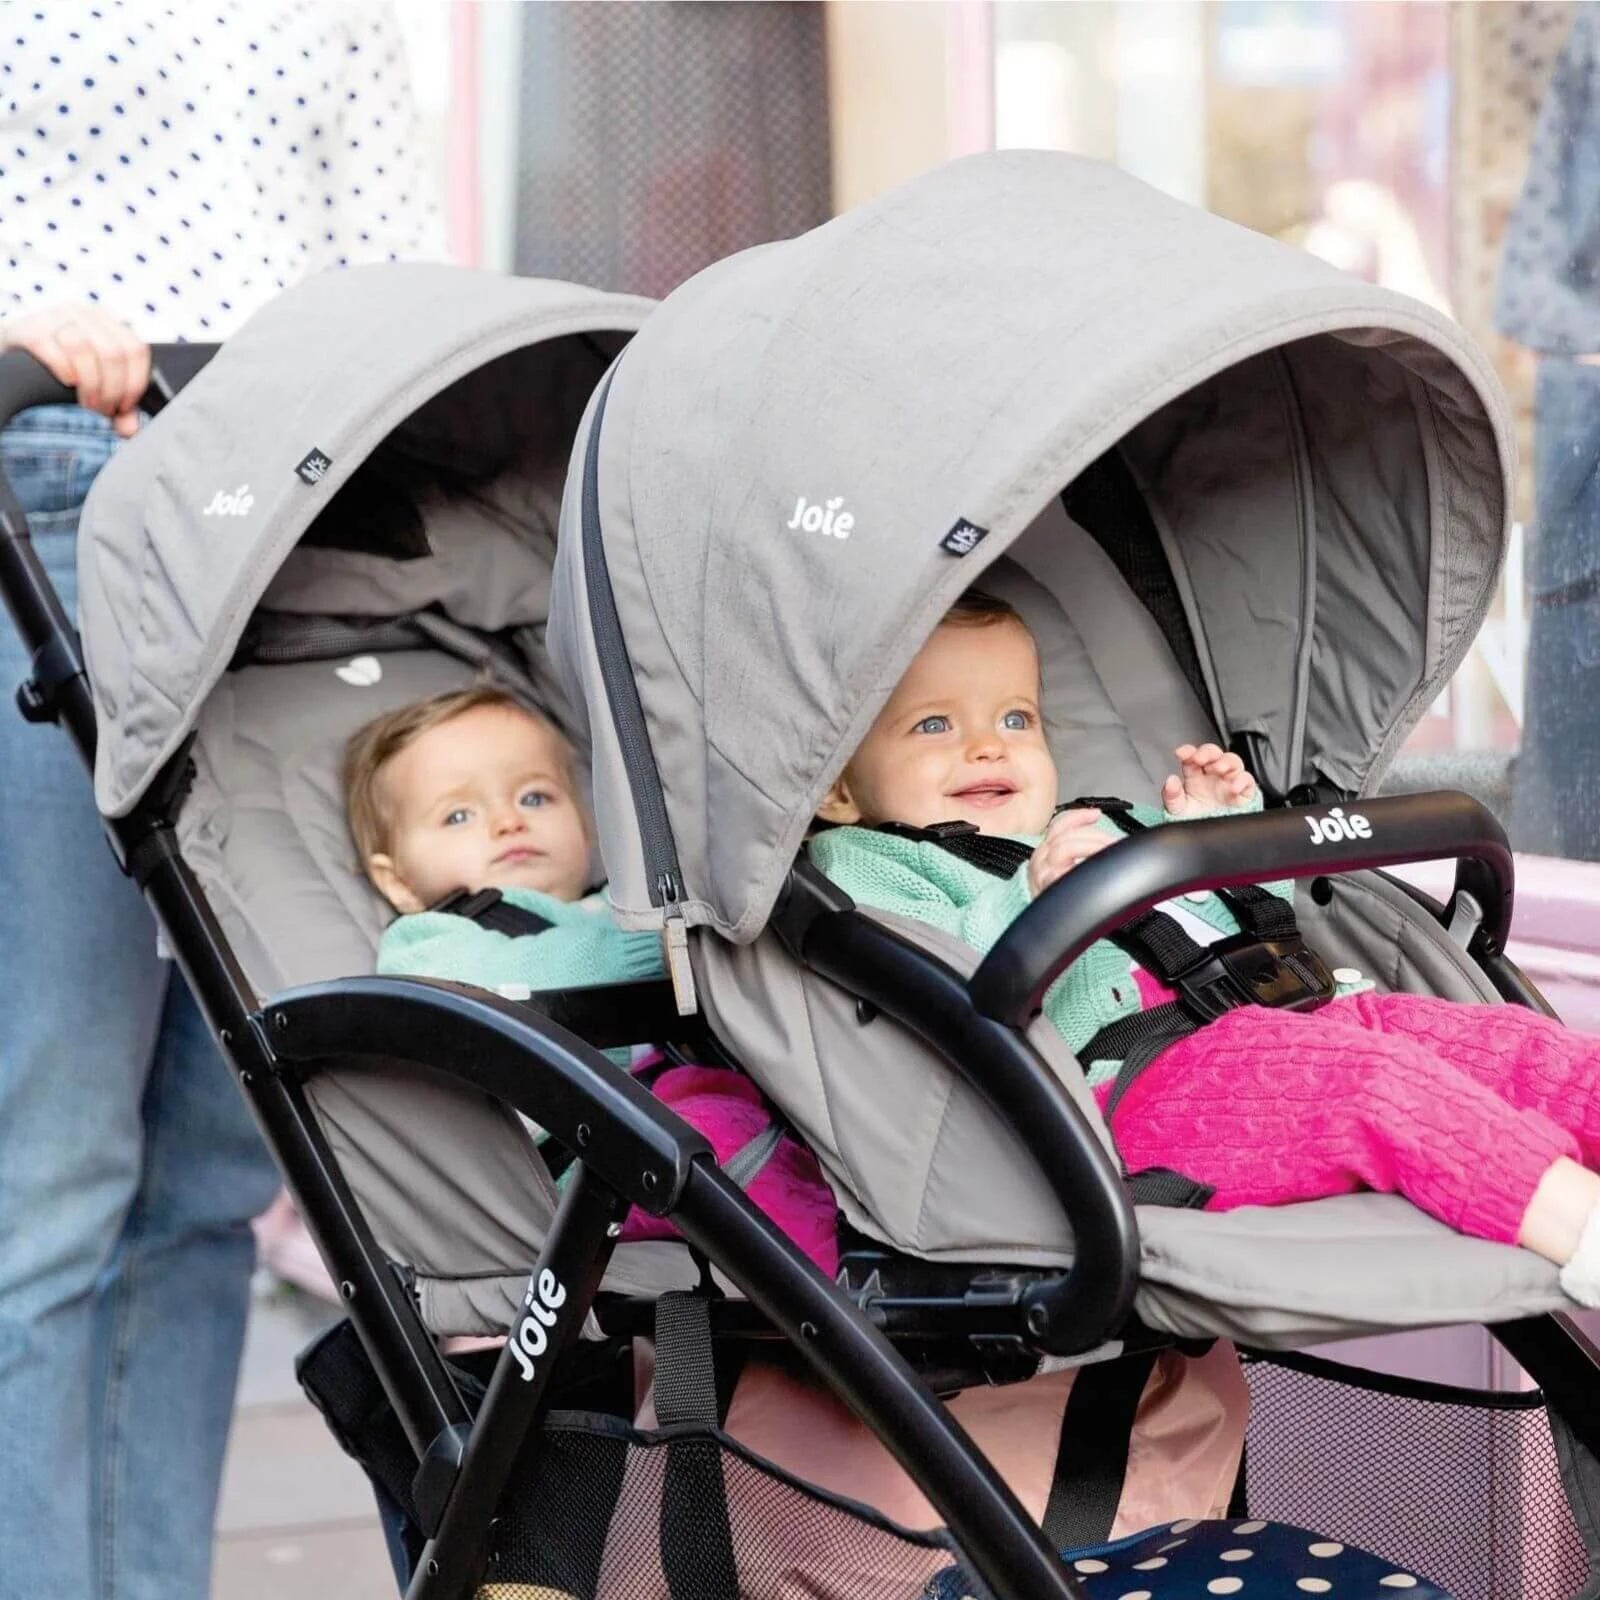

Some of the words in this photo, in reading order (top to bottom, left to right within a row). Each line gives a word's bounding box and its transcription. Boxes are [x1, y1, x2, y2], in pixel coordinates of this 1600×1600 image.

[203, 484, 254, 516] Joie
[787, 497, 855, 540] Joie
[1304, 807, 1373, 845] Joie
[509, 1268, 567, 1382] Joie
